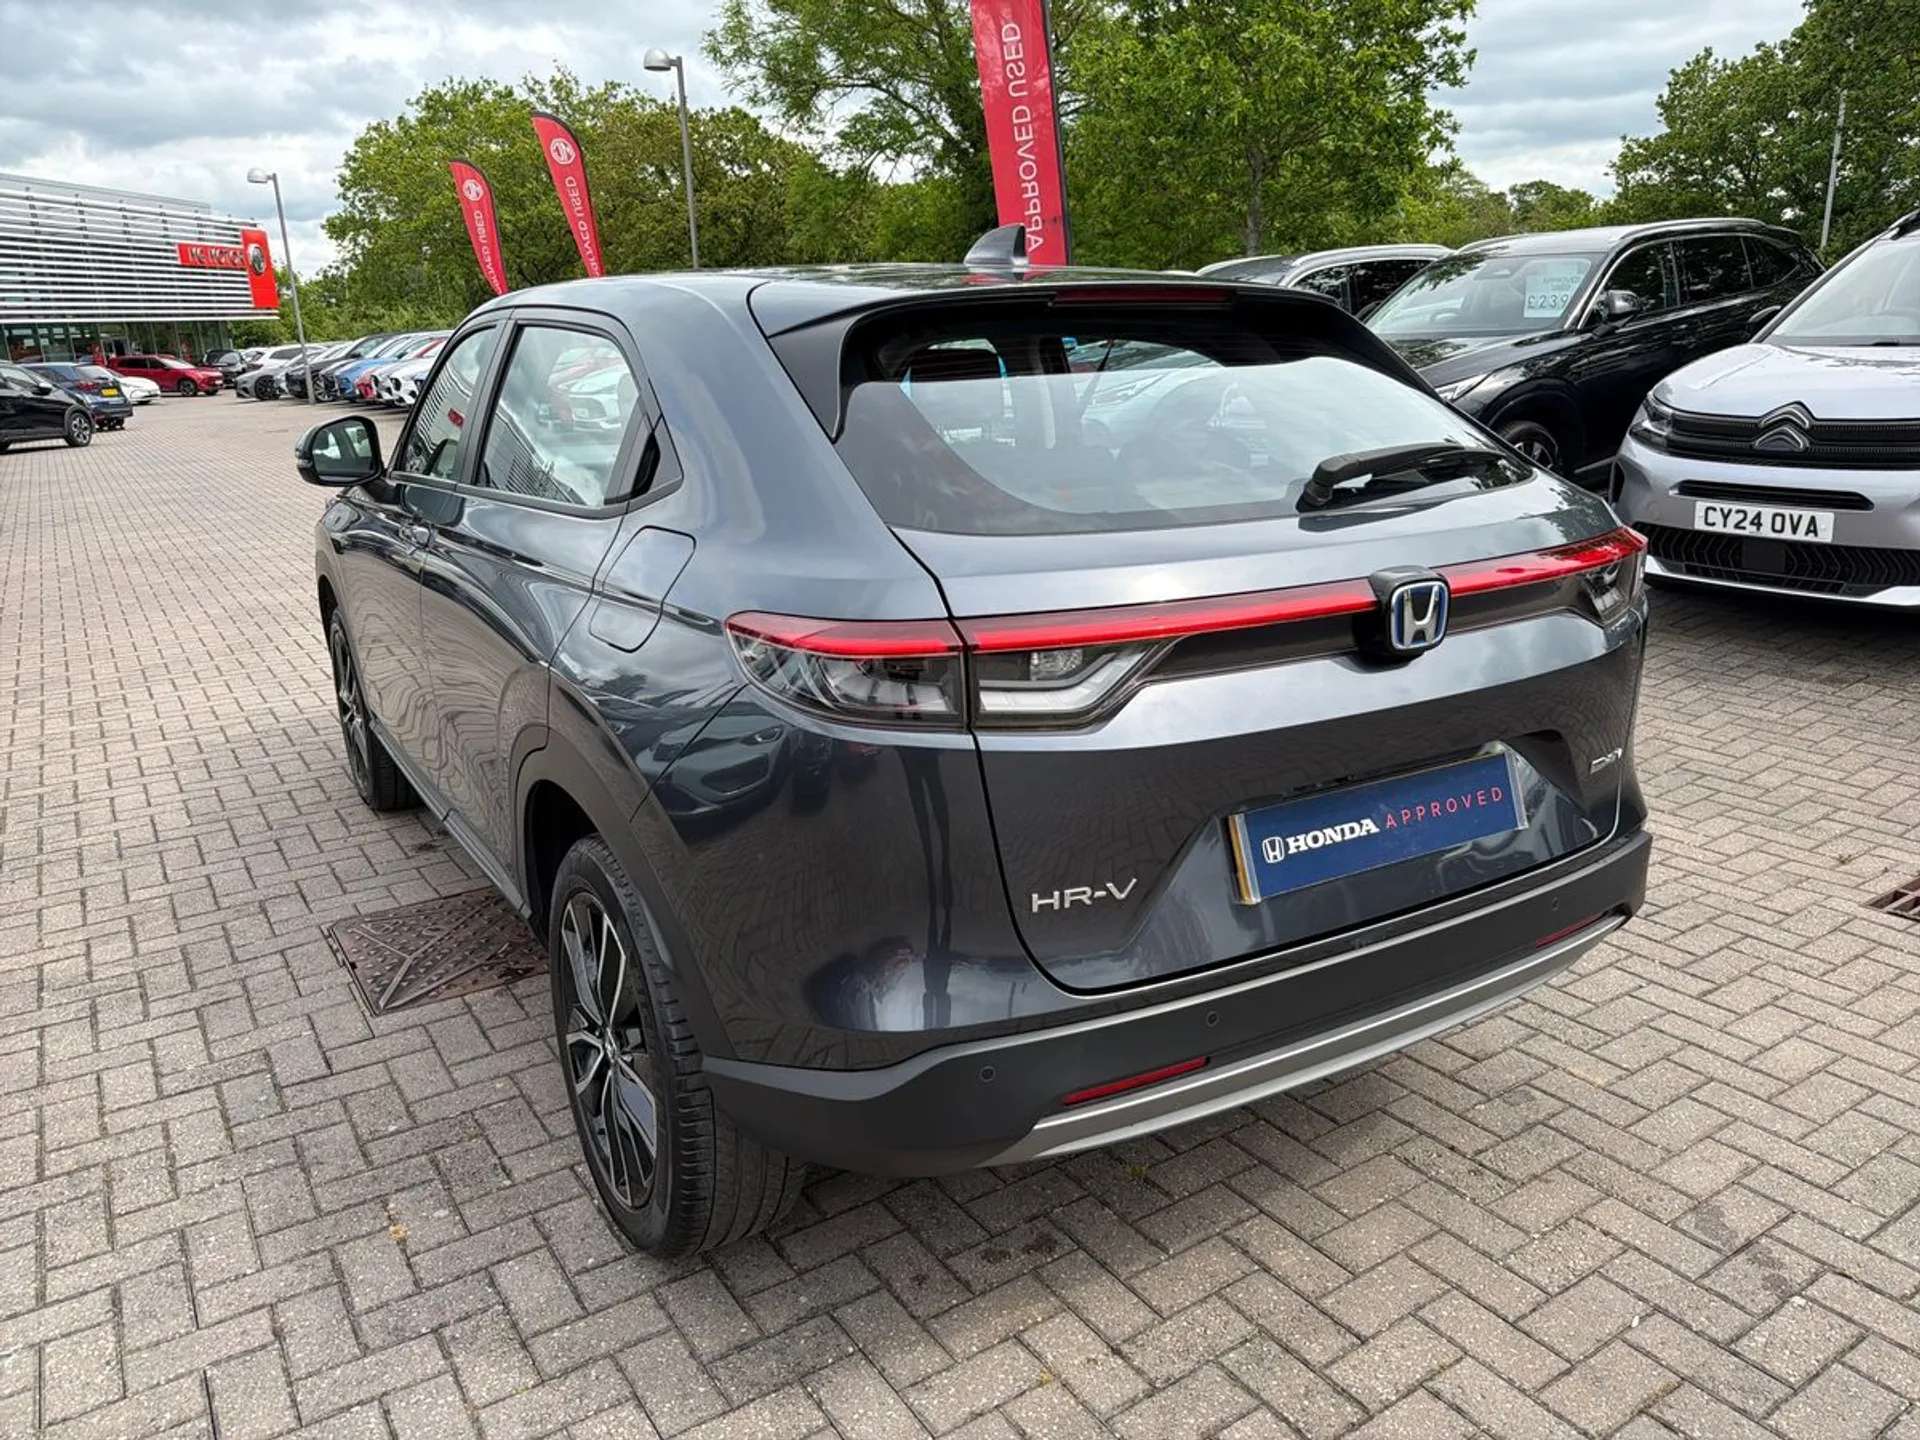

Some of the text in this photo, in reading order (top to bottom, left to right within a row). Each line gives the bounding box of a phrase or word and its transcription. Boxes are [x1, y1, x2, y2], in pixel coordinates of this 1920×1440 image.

[1704, 506, 1818, 538] CY24 OVA
[1287, 818, 1380, 855] HONDA
[1385, 786, 1503, 830] APPROVED
[1031, 878, 1138, 913] HR-V
